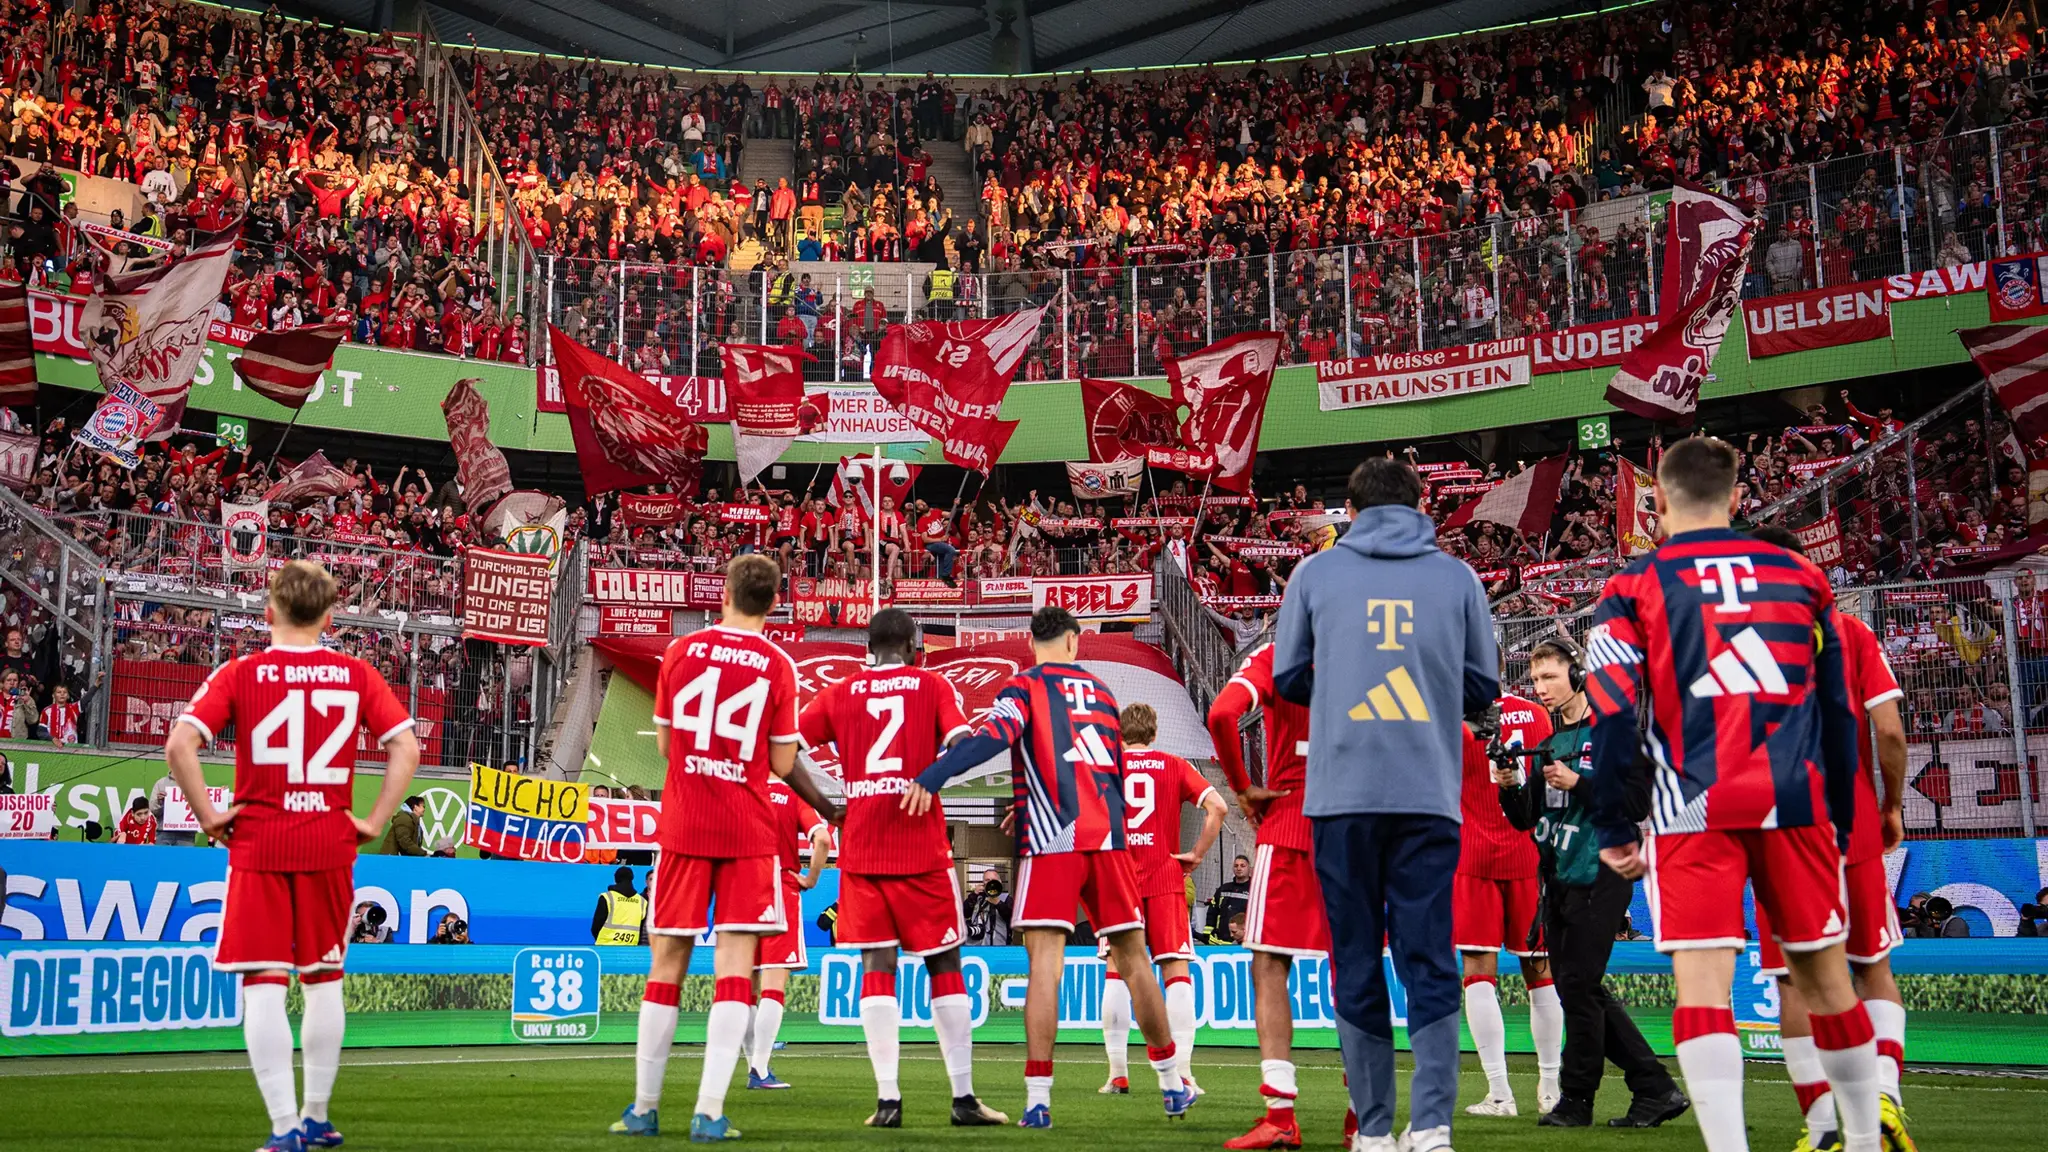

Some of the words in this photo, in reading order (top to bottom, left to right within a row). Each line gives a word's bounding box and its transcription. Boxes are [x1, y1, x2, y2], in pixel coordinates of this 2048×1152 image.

[85, 223, 119, 238] FORZA
[131, 236, 170, 251] BAYERN
[851, 270, 873, 284] 32
[1888, 261, 1987, 299] SAW
[28, 291, 87, 349] BU
[1750, 288, 1883, 335] UELSEN
[1319, 358, 1354, 378] Rot
[1374, 351, 1445, 372] Weisse
[1465, 337, 1526, 360] Traun
[676, 376, 702, 416] 4
[1336, 363, 1512, 404] TRAUNSTEIN
[832, 399, 867, 414] MER
[220, 422, 245, 442] 29
[1581, 424, 1607, 440] 33
[635, 501, 675, 518] Colegio
[1797, 519, 1839, 546] KERIA
[1808, 539, 1843, 564] HEN
[470, 558, 550, 578] DURCHHALTEN
[467, 571, 550, 600] JUNGS!
[594, 571, 686, 603] COLEGIO
[896, 591, 921, 599] IMMER
[1045, 582, 1139, 614] REBELS
[466, 594, 485, 609] NO
[488, 598, 516, 612] ONE
[520, 602, 547, 616] CAN
[611, 608, 628, 618] LOVE
[628, 609, 637, 618] FC
[638, 609, 663, 619] BAYERN
[796, 600, 825, 623] RED
[465, 609, 512, 630] STOP
[516, 616, 546, 634] US!
[615, 622, 632, 632] HATE
[687, 642, 706, 659] FC
[710, 645, 770, 672] BAYERN
[256, 664, 280, 684] FC
[284, 664, 350, 684] BAYERN
[850, 679, 867, 695] FC
[870, 676, 921, 693] BAYERN
[941, 664, 1002, 690] ERN
[672, 665, 772, 762] 44
[1500, 709, 1535, 726] AYERN
[251, 688, 360, 785] 42
[865, 694, 905, 775] 2
[684, 754, 748, 784] STANIŠIĆ
[1127, 759, 1165, 771] BAYERN
[172, 787, 223, 803] LAER
[473, 766, 579, 819] LUCHO
[847, 777, 914, 798] UPAMECAN
[284, 790, 331, 813] KARL
[1124, 772, 1155, 829] 9
[11, 810, 35, 832] 20
[466, 804, 492, 848] EL
[499, 814, 586, 863] FLACO
[585, 802, 661, 843] RED
[1126, 832, 1154, 846] KANE
[613, 932, 636, 944] 2497
[531, 953, 584, 969] Radio
[10, 957, 82, 1028] DIE
[90, 953, 237, 1024] REGION
[529, 969, 583, 1011] 38
[1752, 971, 1781, 1019] 3
[523, 1023, 553, 1037] UKW
